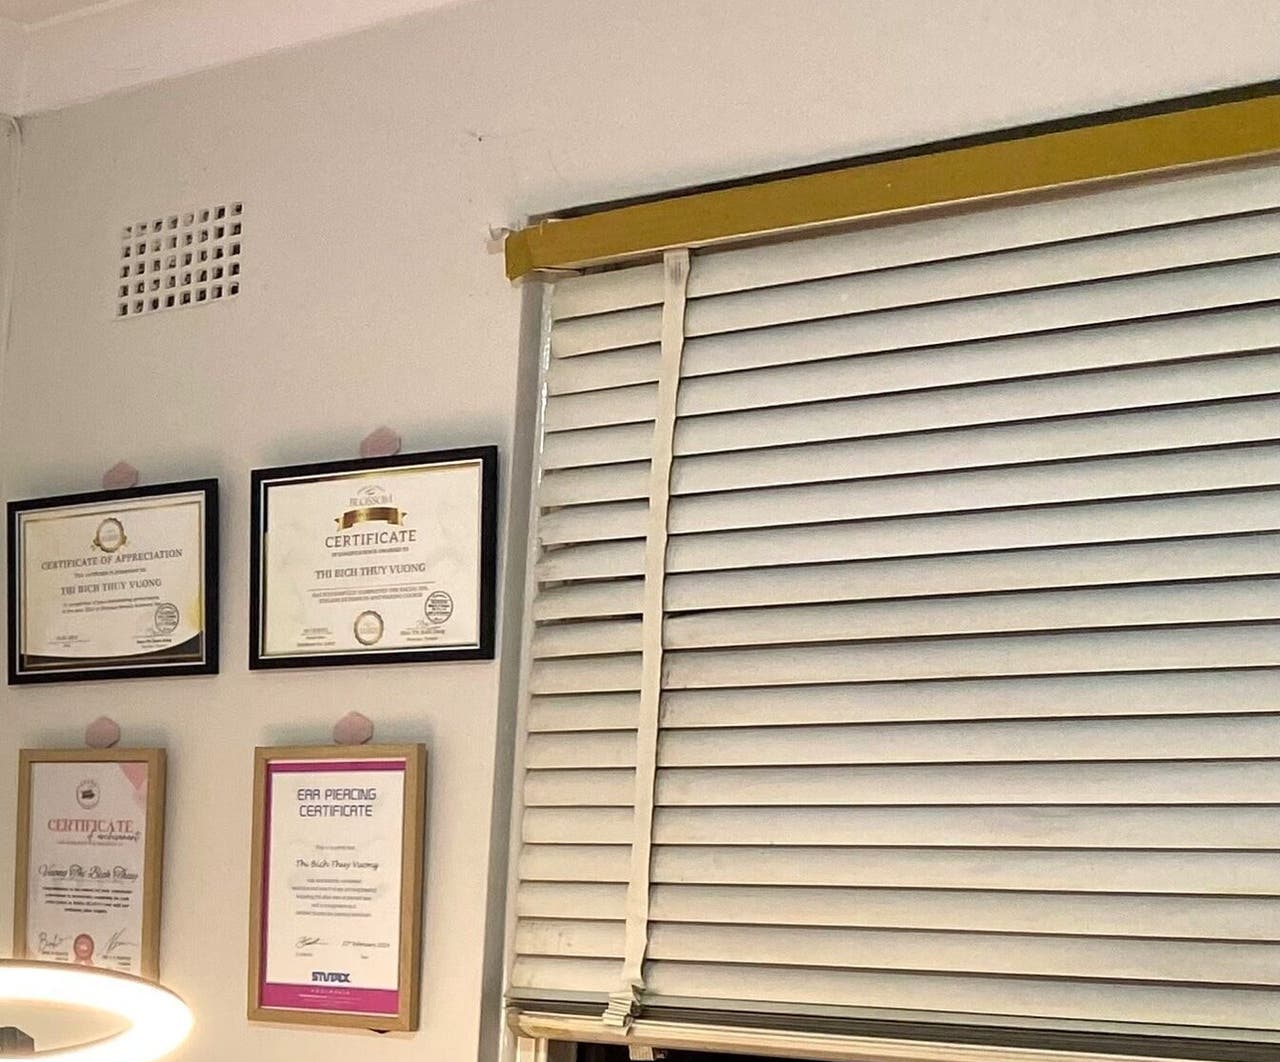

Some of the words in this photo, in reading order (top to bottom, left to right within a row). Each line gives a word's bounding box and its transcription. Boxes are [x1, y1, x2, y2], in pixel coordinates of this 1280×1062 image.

[325, 529, 417, 548] CERTIFICATE
[41, 556, 98, 570] CERTIFICATE
[100, 555, 113, 565] OF
[116, 549, 183, 564] APPRECIATION
[388, 563, 426, 574] VUONG
[297, 788, 321, 801] EAR
[324, 788, 377, 801] PIERCING
[299, 805, 373, 817] CERTIFICATE
[48, 819, 133, 832] CERTIFICATE
